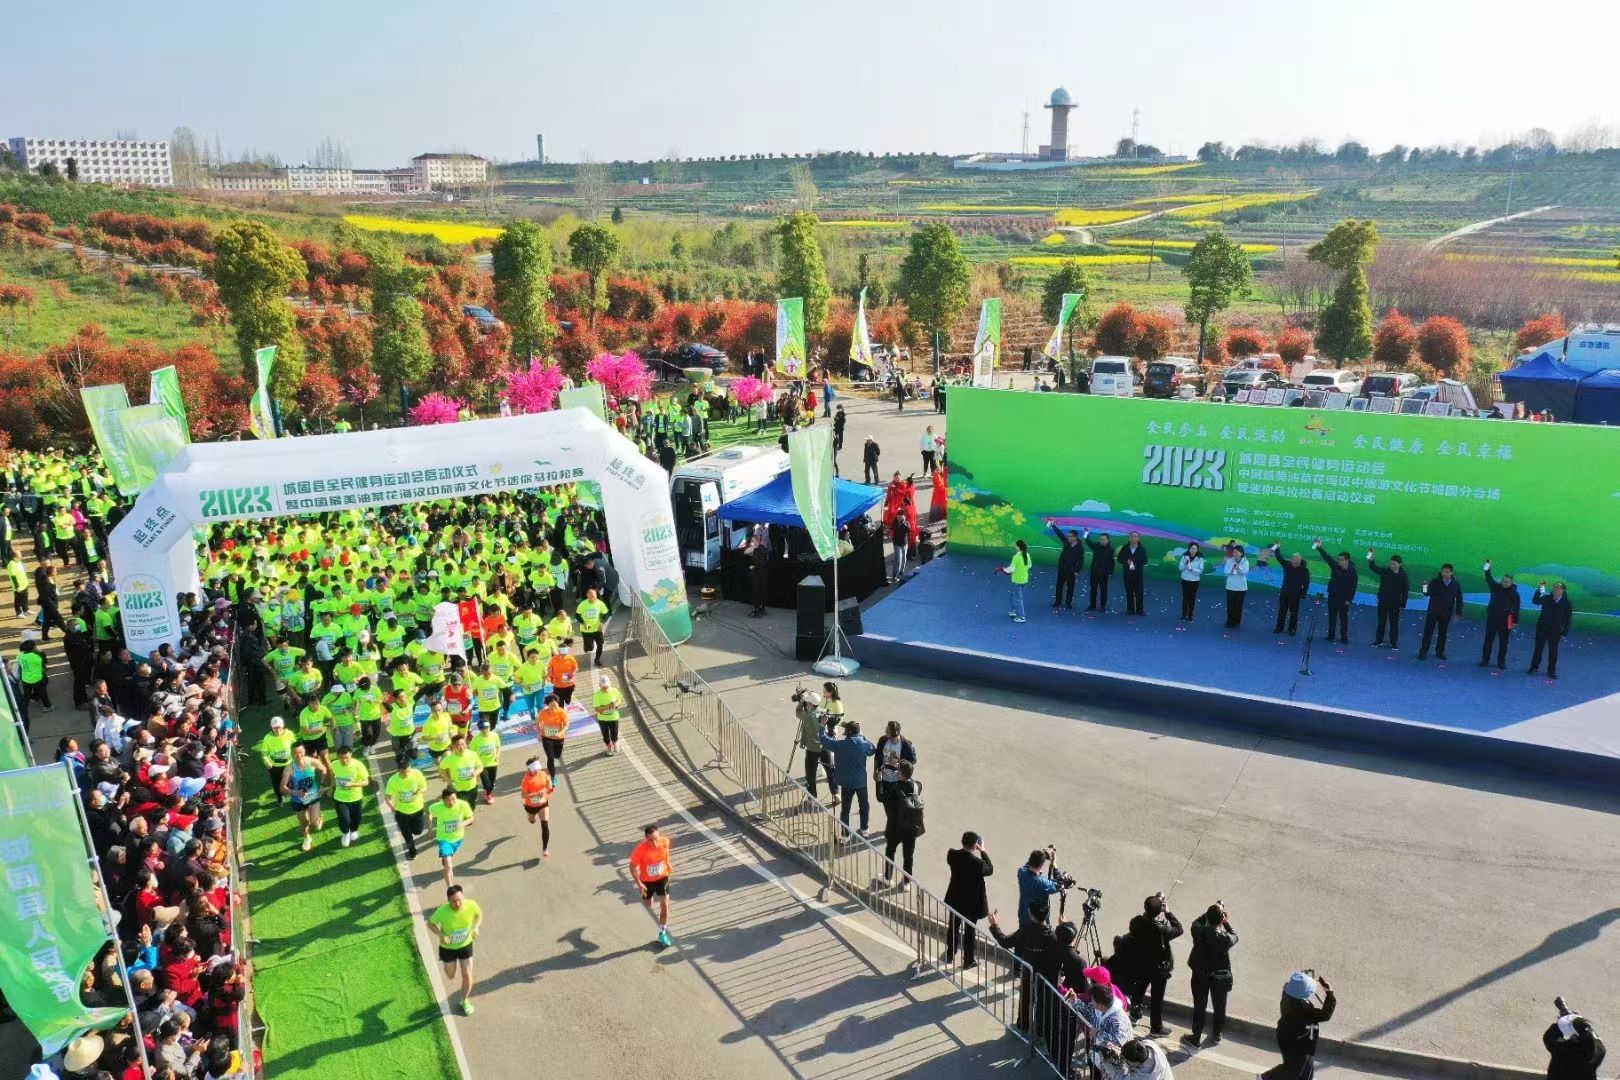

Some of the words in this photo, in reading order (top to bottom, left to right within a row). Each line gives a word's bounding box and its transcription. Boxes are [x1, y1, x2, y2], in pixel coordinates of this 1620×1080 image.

[1142, 444, 1226, 491] 2023
[199, 485, 273, 518] 2023
[133, 505, 171, 544] 起终点
[143, 531, 158, 549] START
[160, 513, 177, 530] FINISH
[643, 525, 674, 543] 2023
[124, 590, 164, 610] 2023
